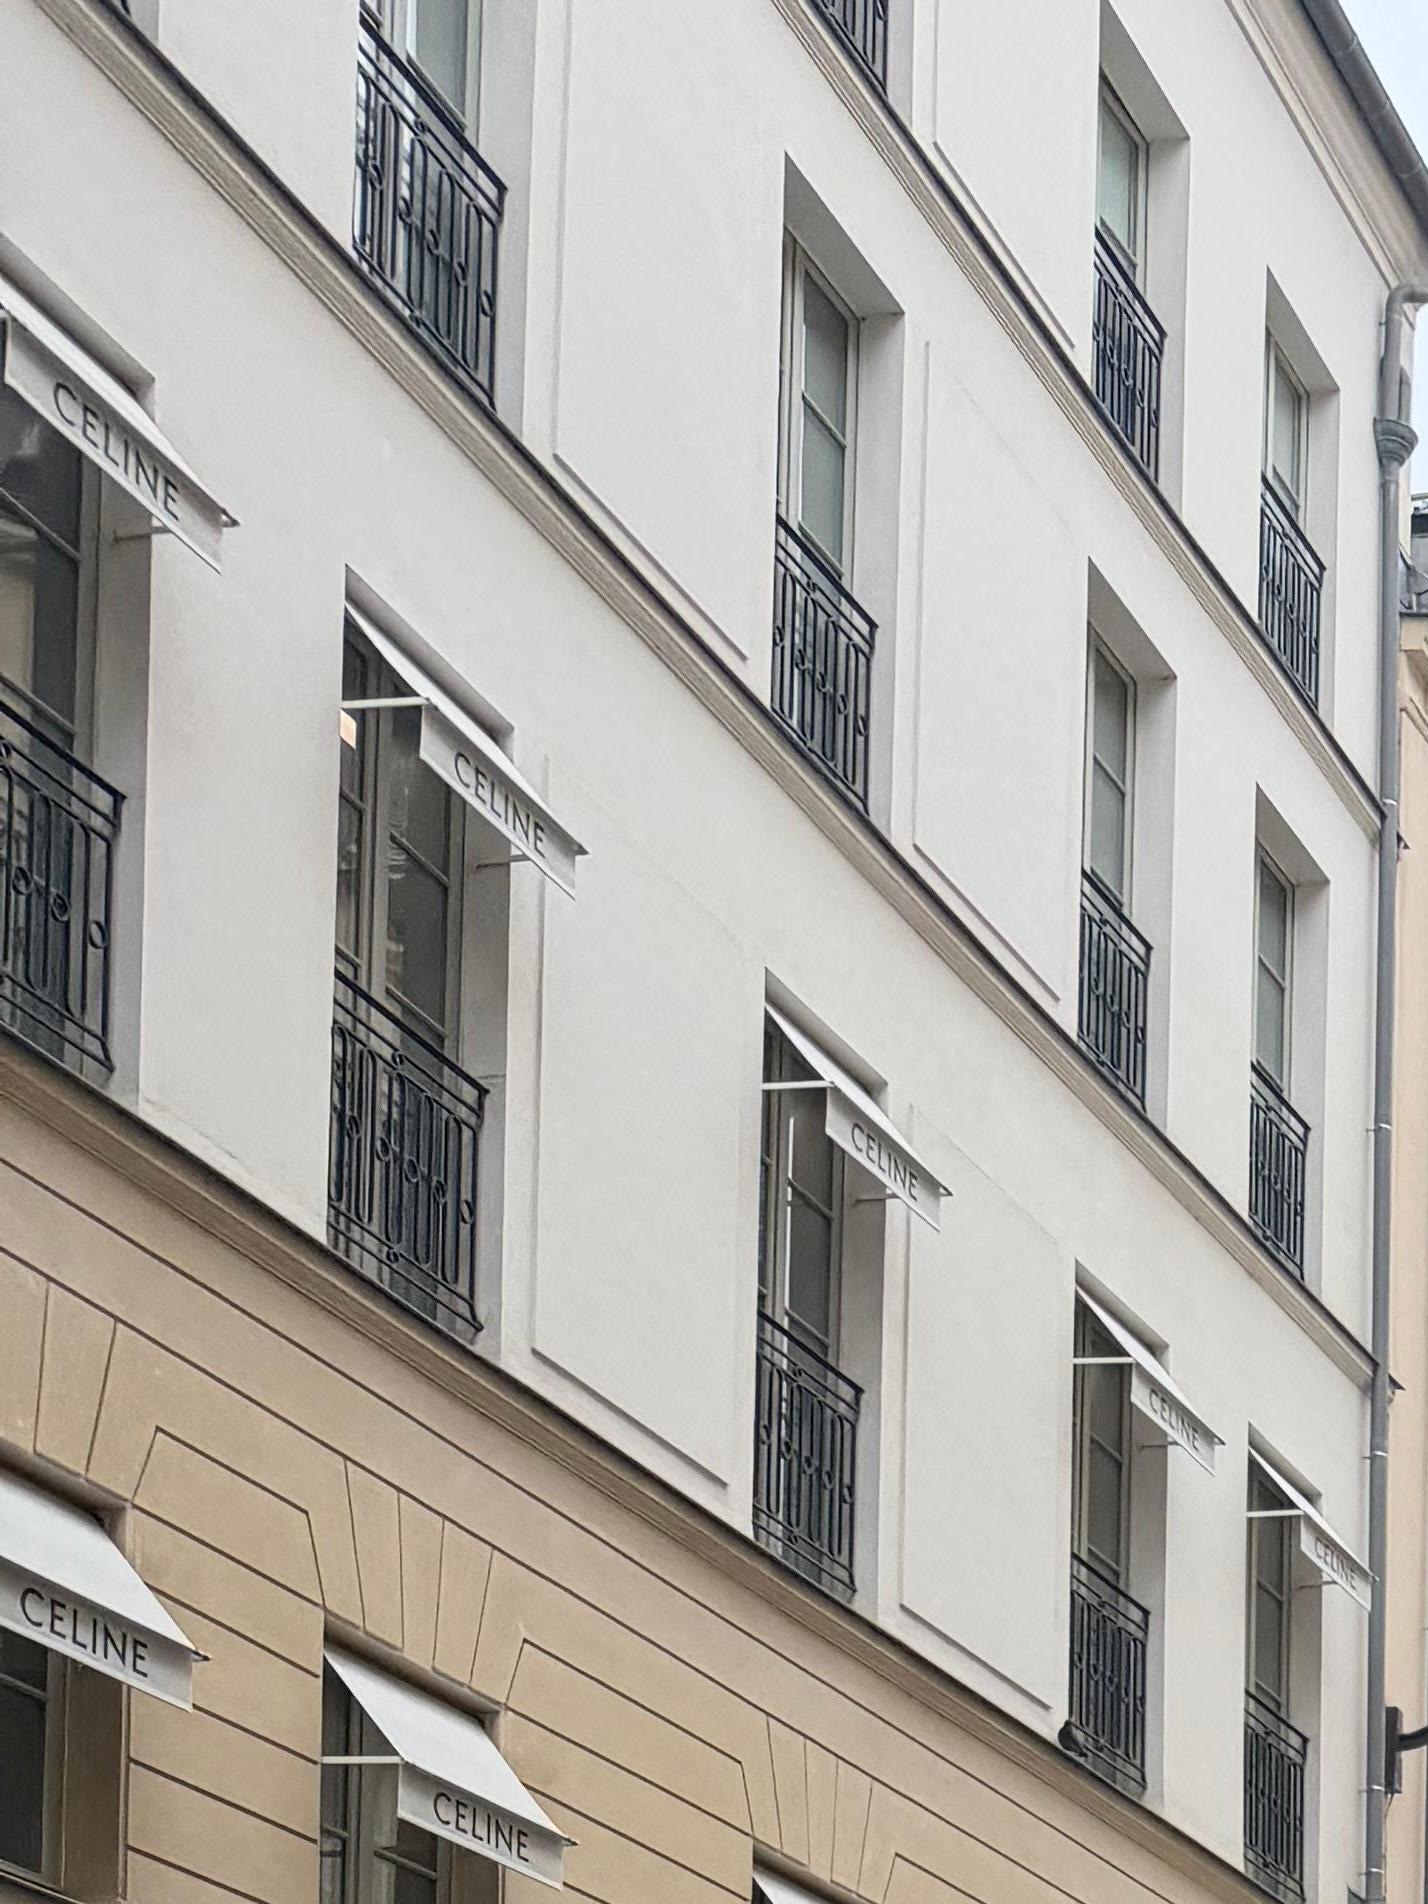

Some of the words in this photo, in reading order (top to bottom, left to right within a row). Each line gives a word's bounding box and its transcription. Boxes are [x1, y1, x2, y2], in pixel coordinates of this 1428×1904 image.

[53, 382, 180, 524] CELINE
[454, 751, 548, 861] CELINE
[851, 1123, 919, 1202] CELINE
[1149, 1388, 1203, 1452] CELINE
[1314, 1535, 1358, 1592] CELINE
[20, 1586, 150, 1681] CELINE
[433, 1791, 531, 1864] CELINE
